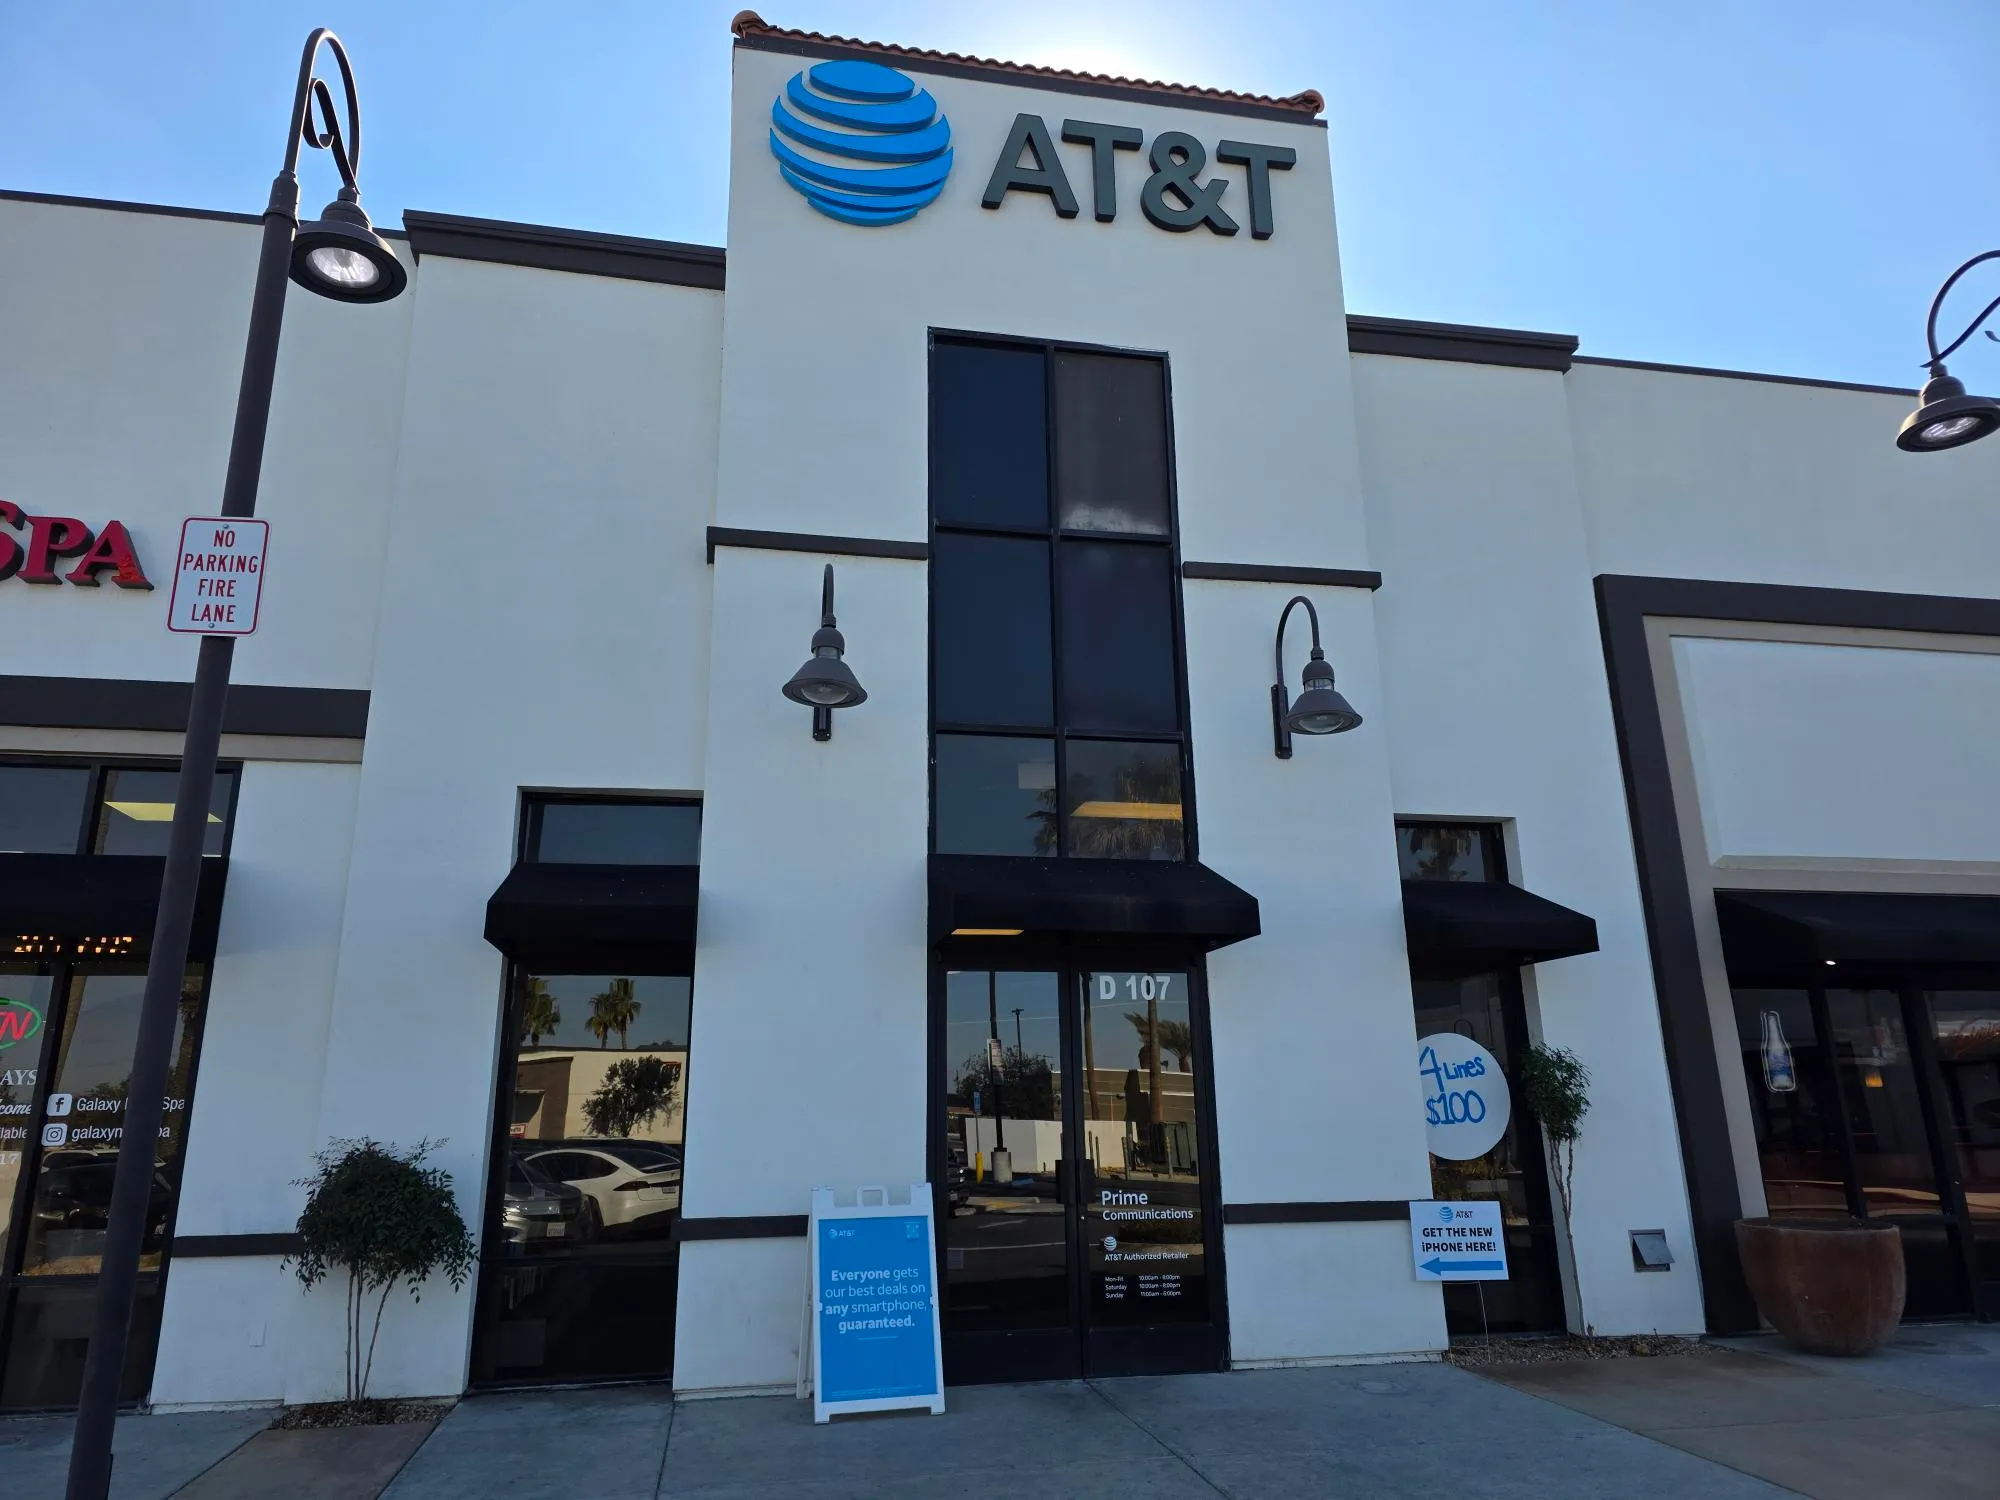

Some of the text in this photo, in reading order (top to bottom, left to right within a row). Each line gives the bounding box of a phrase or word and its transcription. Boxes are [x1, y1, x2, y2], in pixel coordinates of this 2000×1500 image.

[981, 113, 1297, 240] AT&T
[0, 500, 155, 591] SPA
[213, 530, 236, 548] NO
[182, 553, 259, 574] PARKING
[197, 578, 237, 598] FIRE
[190, 603, 237, 624] LANE
[1099, 975, 1171, 1001] D 107
[1419, 1046, 1486, 1093] 4 Lines
[76, 1097, 122, 1113] Galaxy
[162, 1096, 185, 1112] Spa
[1426, 1090, 1486, 1126] $100
[1101, 1189, 1149, 1206] Prime
[1102, 1208, 1194, 1221] Communications
[1455, 1210, 1473, 1219] AT&T
[1422, 1227, 1493, 1237] GET THE NEW
[1421, 1242, 1497, 1252] iPHONE HERE!
[1104, 1251, 1189, 1262] AT&T Authorized Retailer
[831, 1266, 919, 1283] Everyone gets
[825, 1282, 926, 1298] our best deals on
[825, 1300, 927, 1317] any smartphone,
[838, 1314, 916, 1334] guaranteed.
